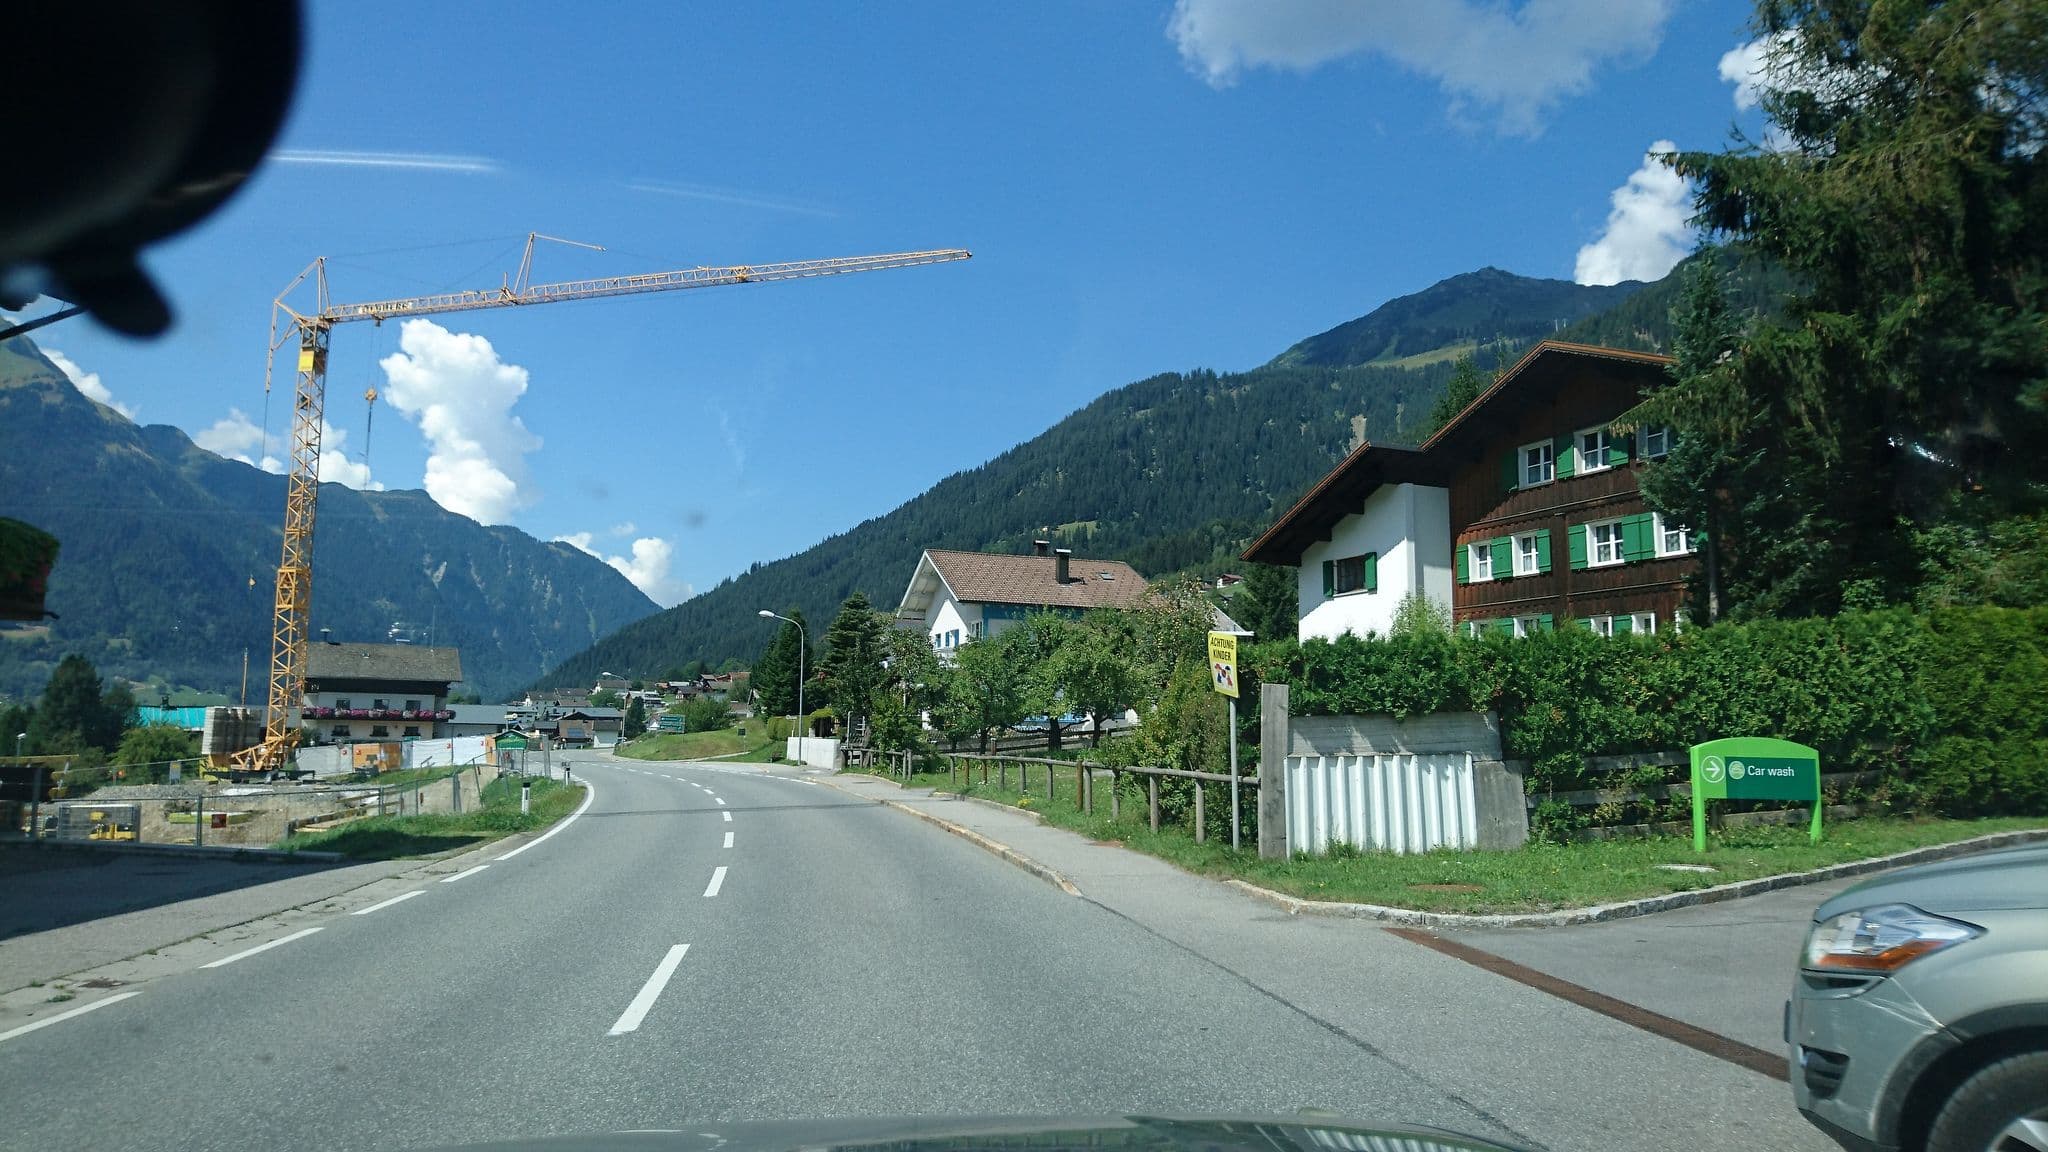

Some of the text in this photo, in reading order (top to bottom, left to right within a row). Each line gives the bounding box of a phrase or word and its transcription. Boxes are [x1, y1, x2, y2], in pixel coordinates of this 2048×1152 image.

[1210, 637, 1234, 650] ACHTUNG
[1213, 649, 1232, 661] KINDER
[1747, 765, 1795, 777] Car wash
